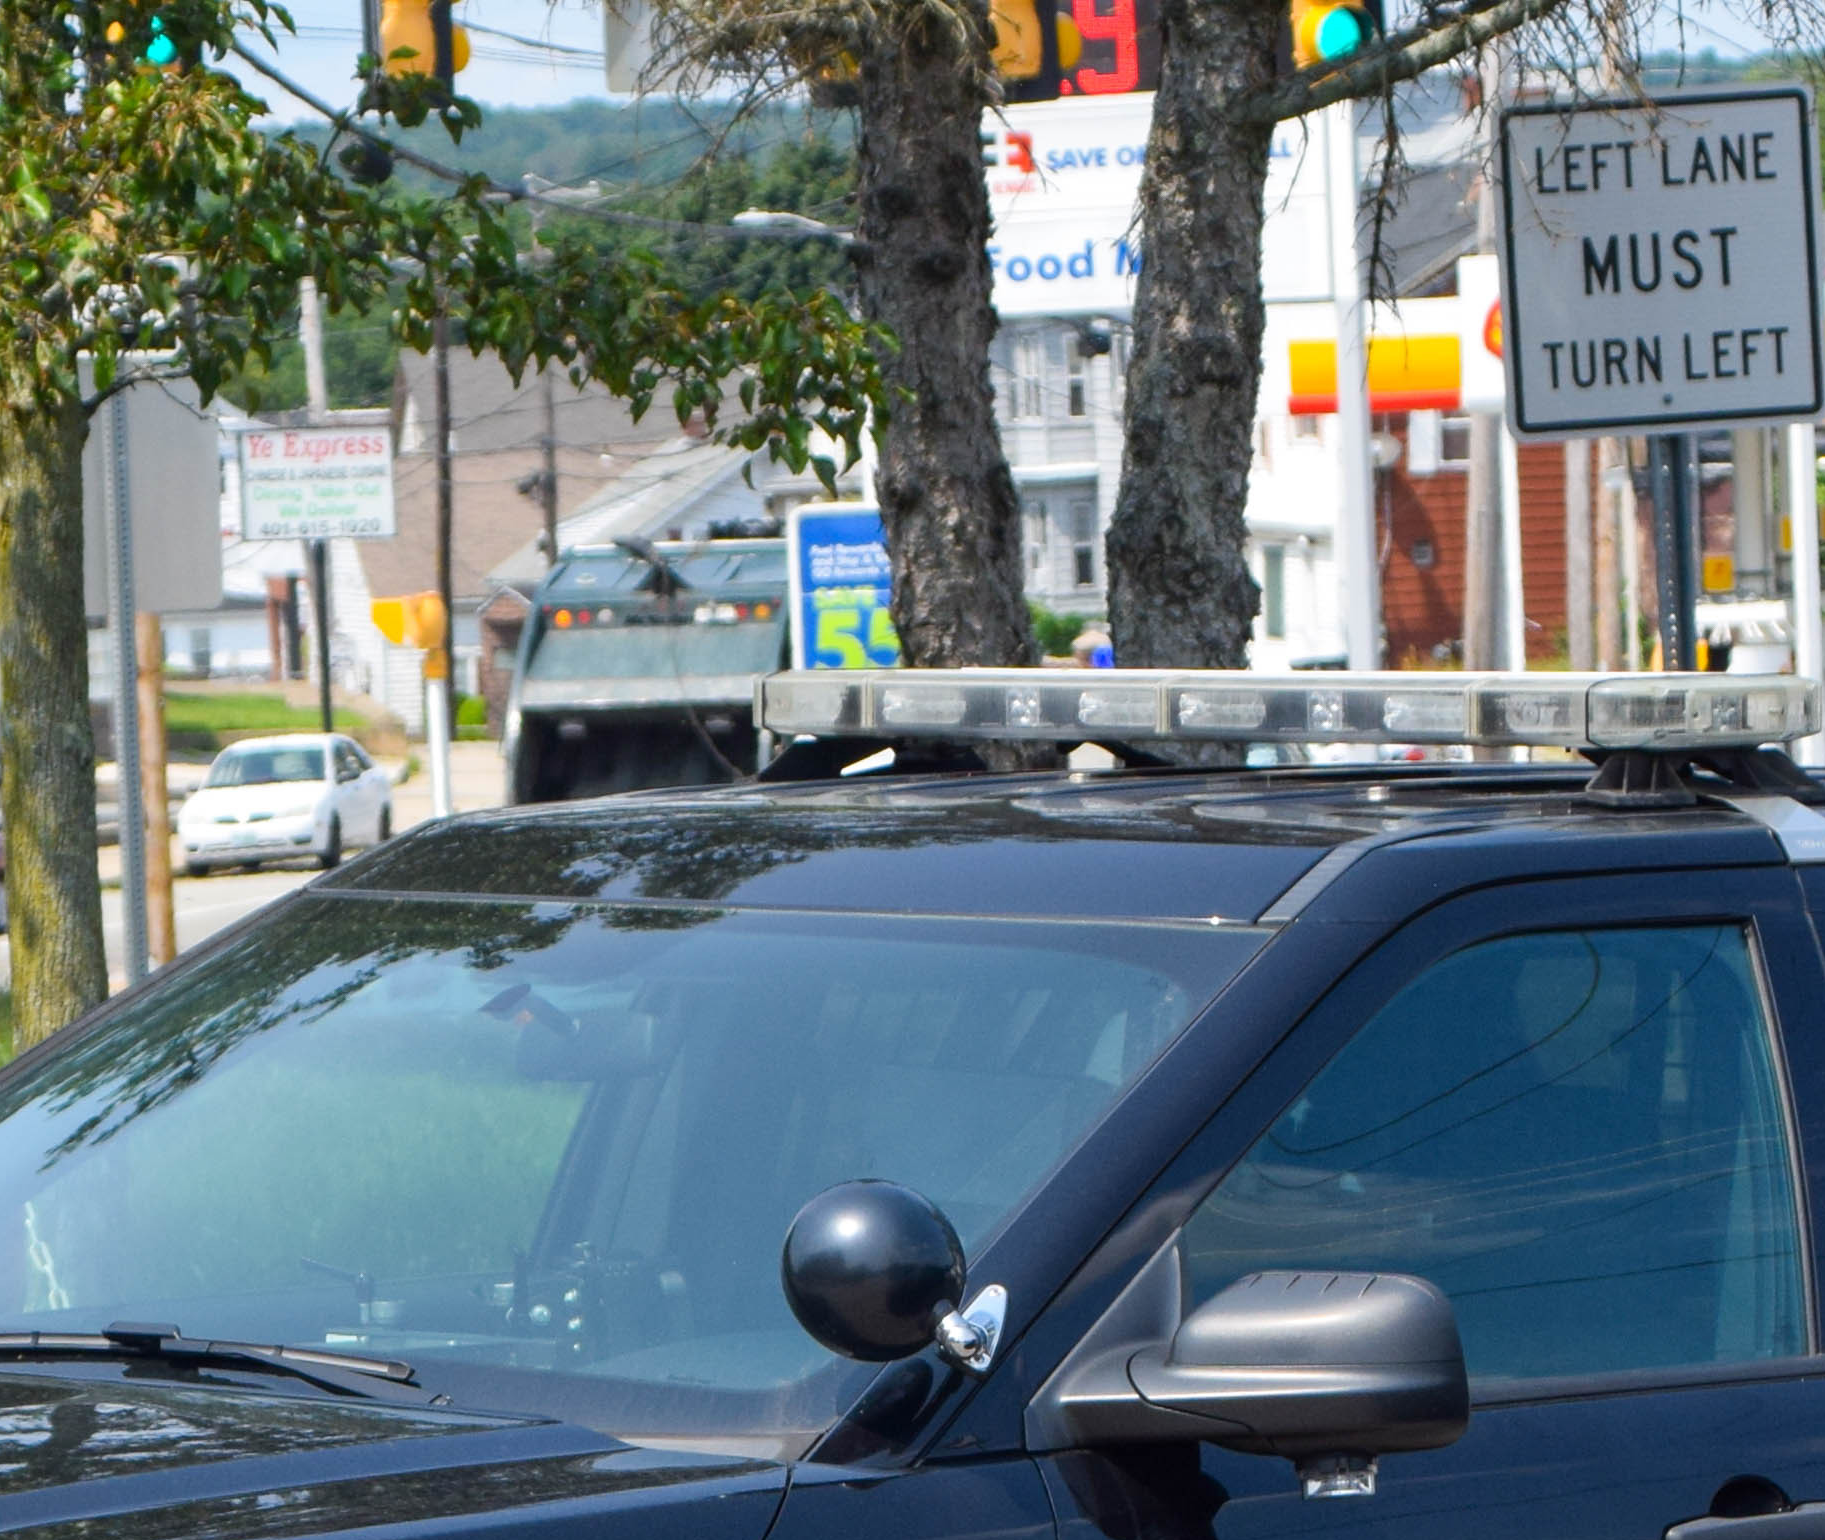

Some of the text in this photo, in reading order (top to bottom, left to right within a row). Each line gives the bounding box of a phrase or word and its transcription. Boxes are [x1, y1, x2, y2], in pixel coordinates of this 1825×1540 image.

[1046, 147, 1107, 171] SAVE
[1536, 131, 1777, 194] LEFT LANE
[1582, 226, 1738, 296] MUST
[1542, 326, 1789, 389] TURN LEFT
[248, 431, 384, 463] Ye Express
